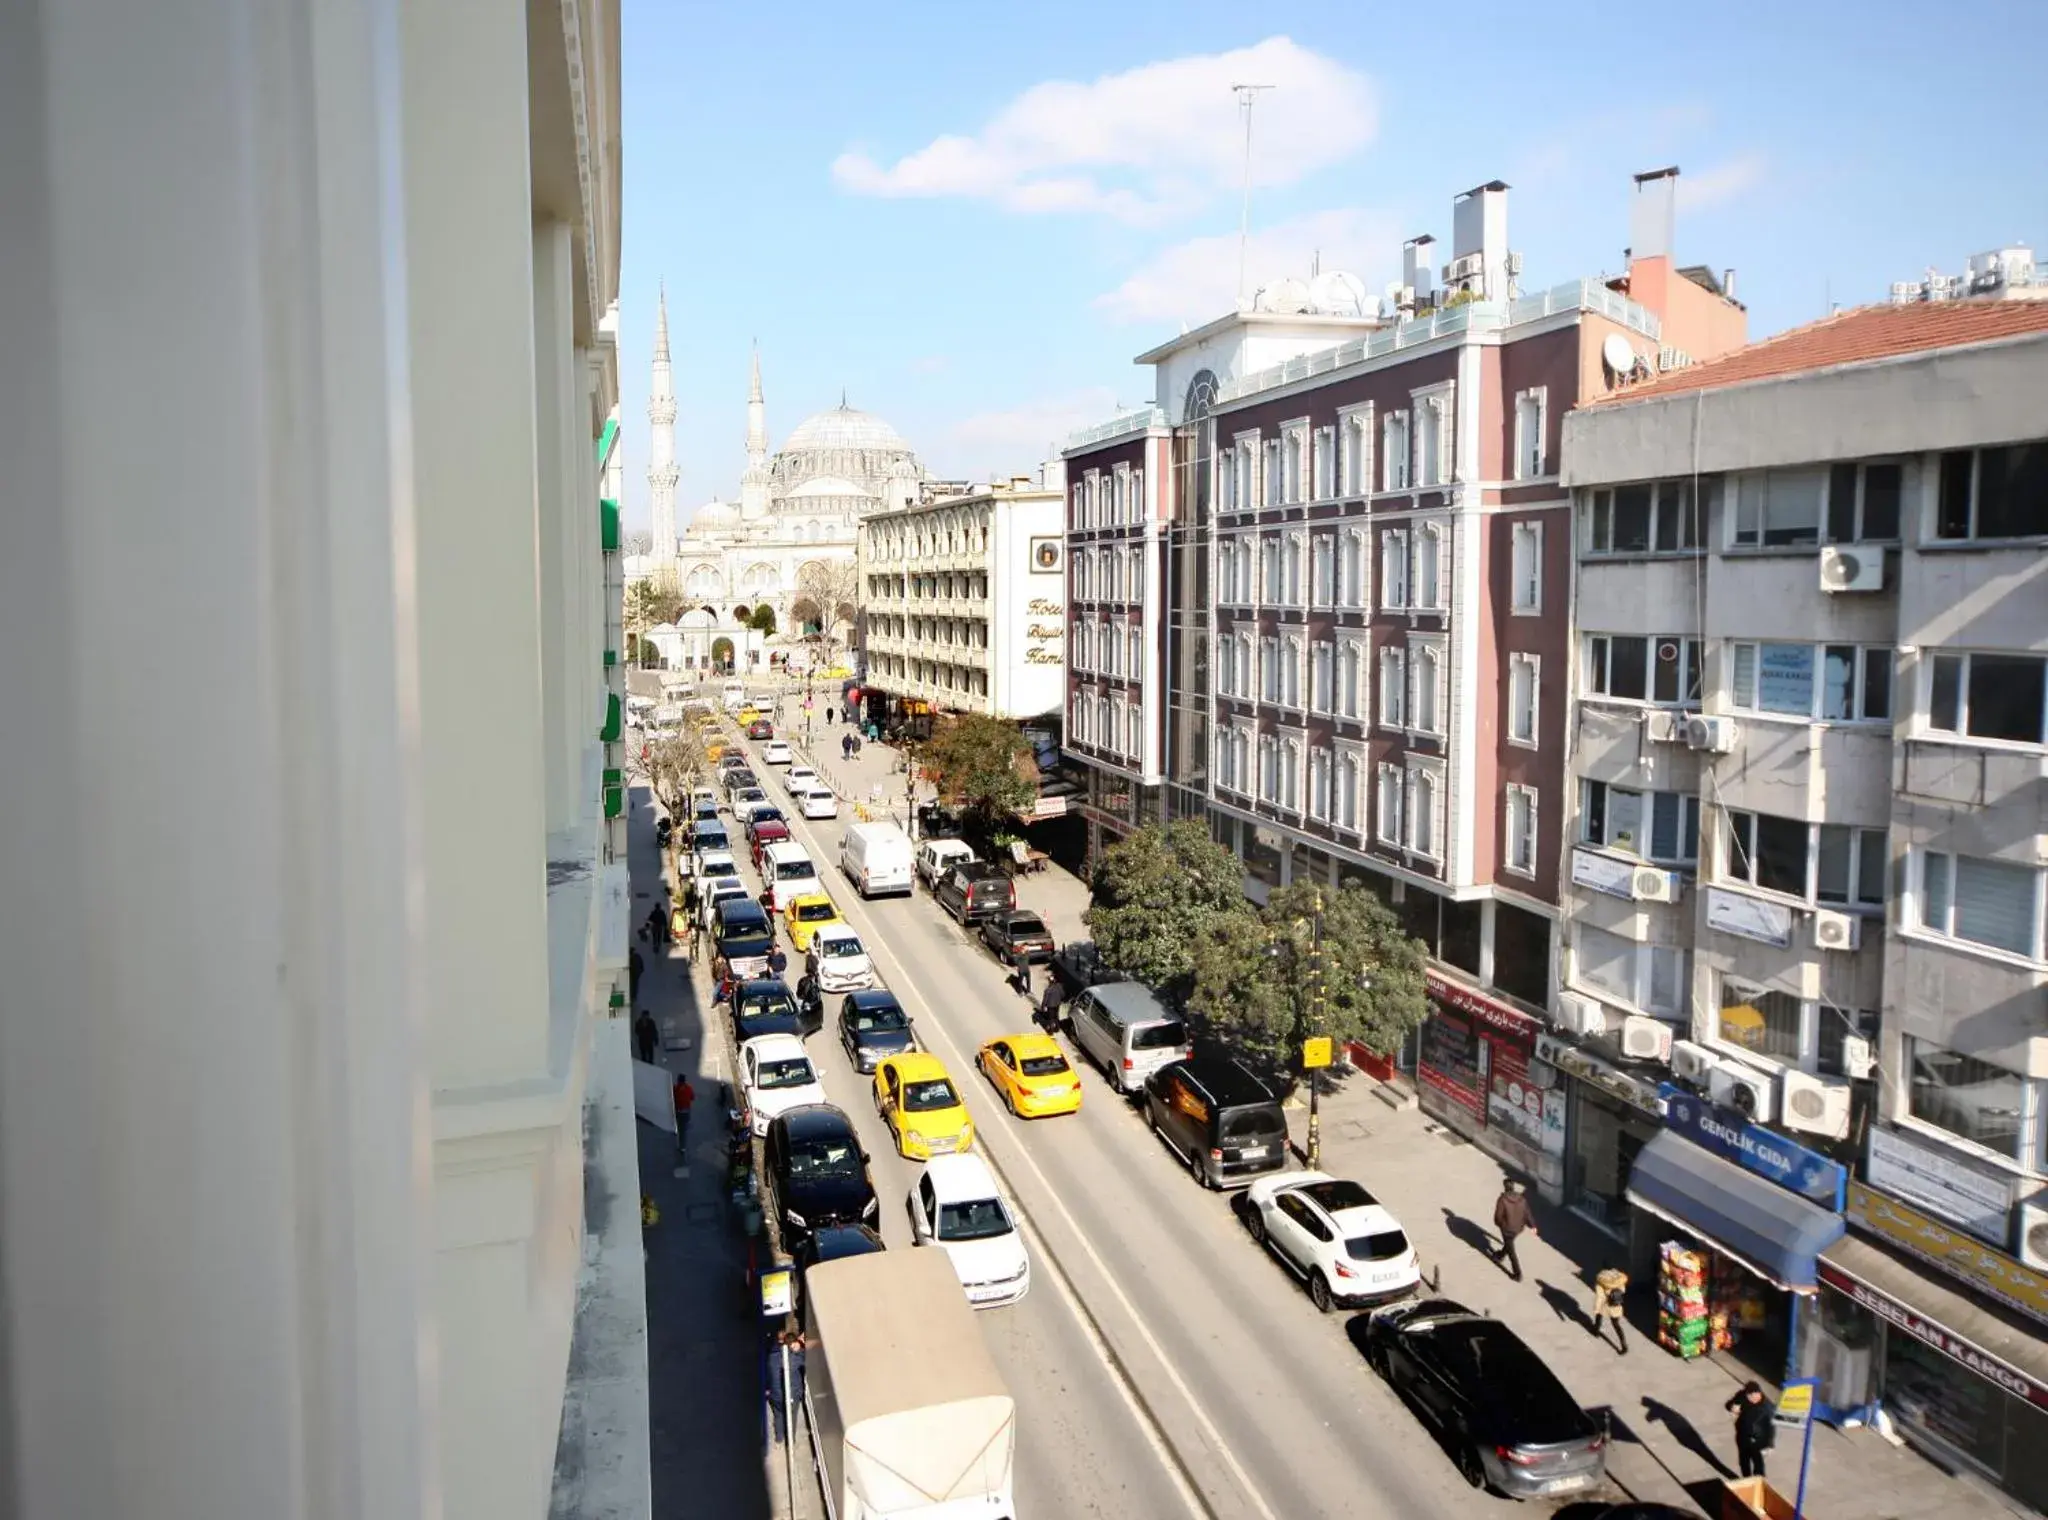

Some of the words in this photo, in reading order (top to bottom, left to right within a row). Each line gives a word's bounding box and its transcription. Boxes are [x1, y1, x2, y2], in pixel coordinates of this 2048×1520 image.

[1700, 1116, 1755, 1153] GENÇLİK
[1757, 1144, 1792, 1173] GIDA
[1947, 1337, 2031, 1397] KARGO
